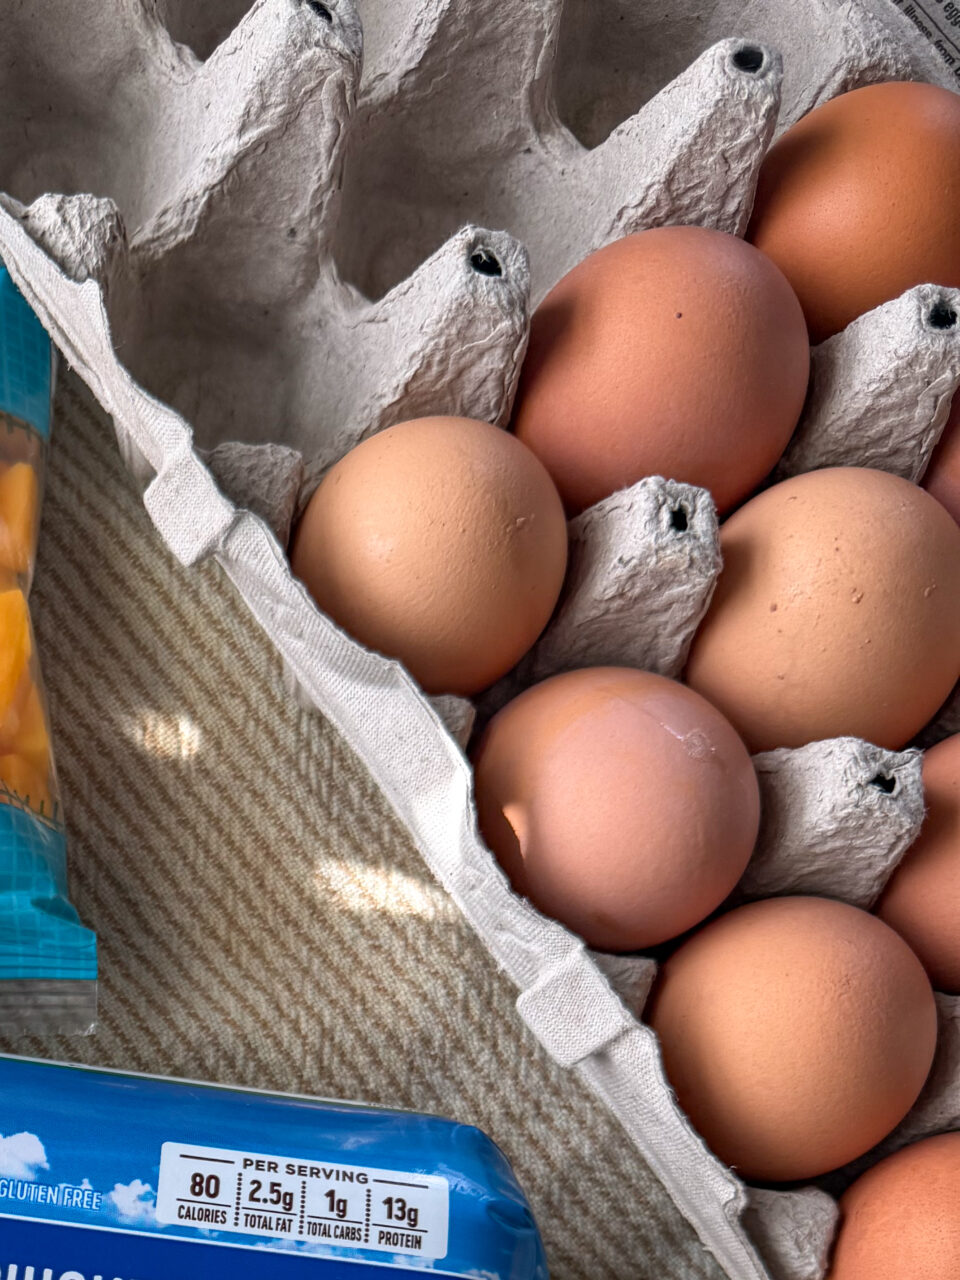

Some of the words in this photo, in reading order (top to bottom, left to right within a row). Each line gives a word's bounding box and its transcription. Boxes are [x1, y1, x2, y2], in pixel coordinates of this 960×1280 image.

[243, 1158, 279, 1174] PER
[285, 1164, 369, 1185] SERVING
[190, 1173, 220, 1199] 80
[248, 1179, 294, 1212] 2.5g
[62, 1187, 103, 1210] FREE
[324, 1189, 348, 1218] 1g
[177, 1204, 227, 1225] CALORIES
[244, 1213, 275, 1231] TOTAL
[275, 1218, 293, 1233] FAT
[382, 1197, 419, 1228] 13g
[307, 1221, 333, 1238] TOTAL
[333, 1224, 362, 1242] CARBS
[378, 1230, 422, 1250] PROTEIN
